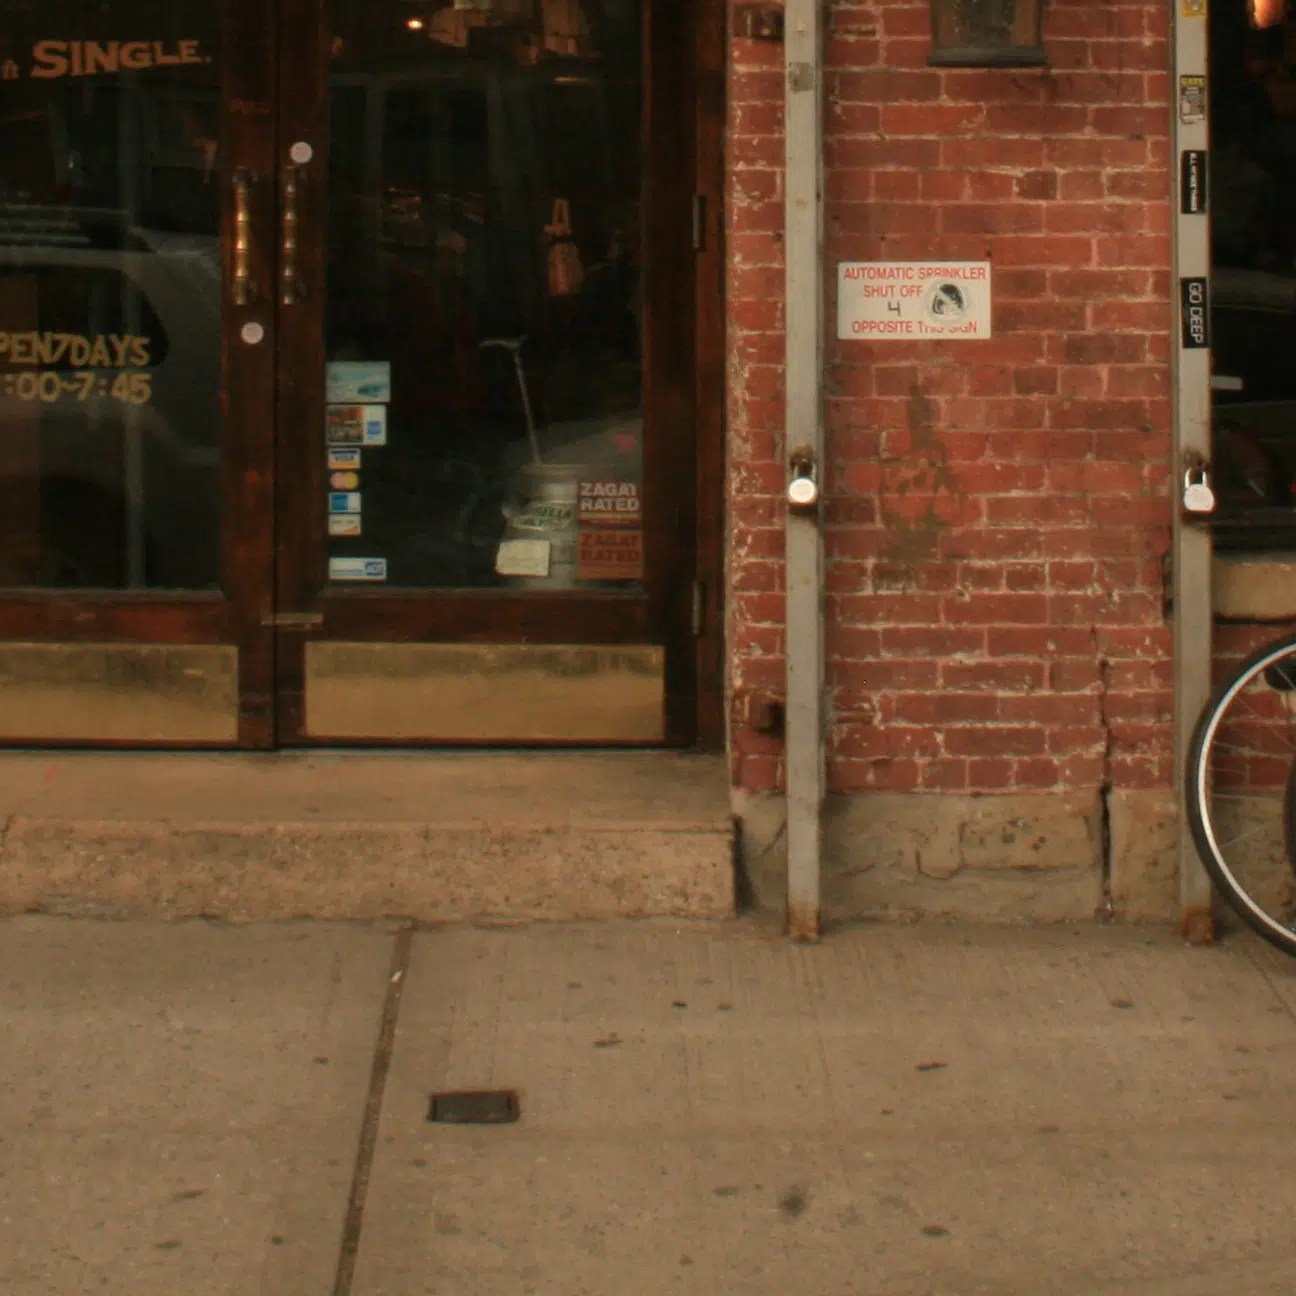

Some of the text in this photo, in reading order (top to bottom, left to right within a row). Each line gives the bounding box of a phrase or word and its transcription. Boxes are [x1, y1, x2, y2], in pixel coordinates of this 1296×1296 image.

[844, 267, 986, 280] AUTOMATIC SPRINKLER
[864, 285, 923, 298] SHUT OFF
[888, 301, 901, 316] 4
[1188, 282, 1204, 343] GO DEEP
[852, 321, 912, 334] OPPOSITE
[581, 482, 637, 496] ZAGAT
[581, 497, 640, 511] RATED
